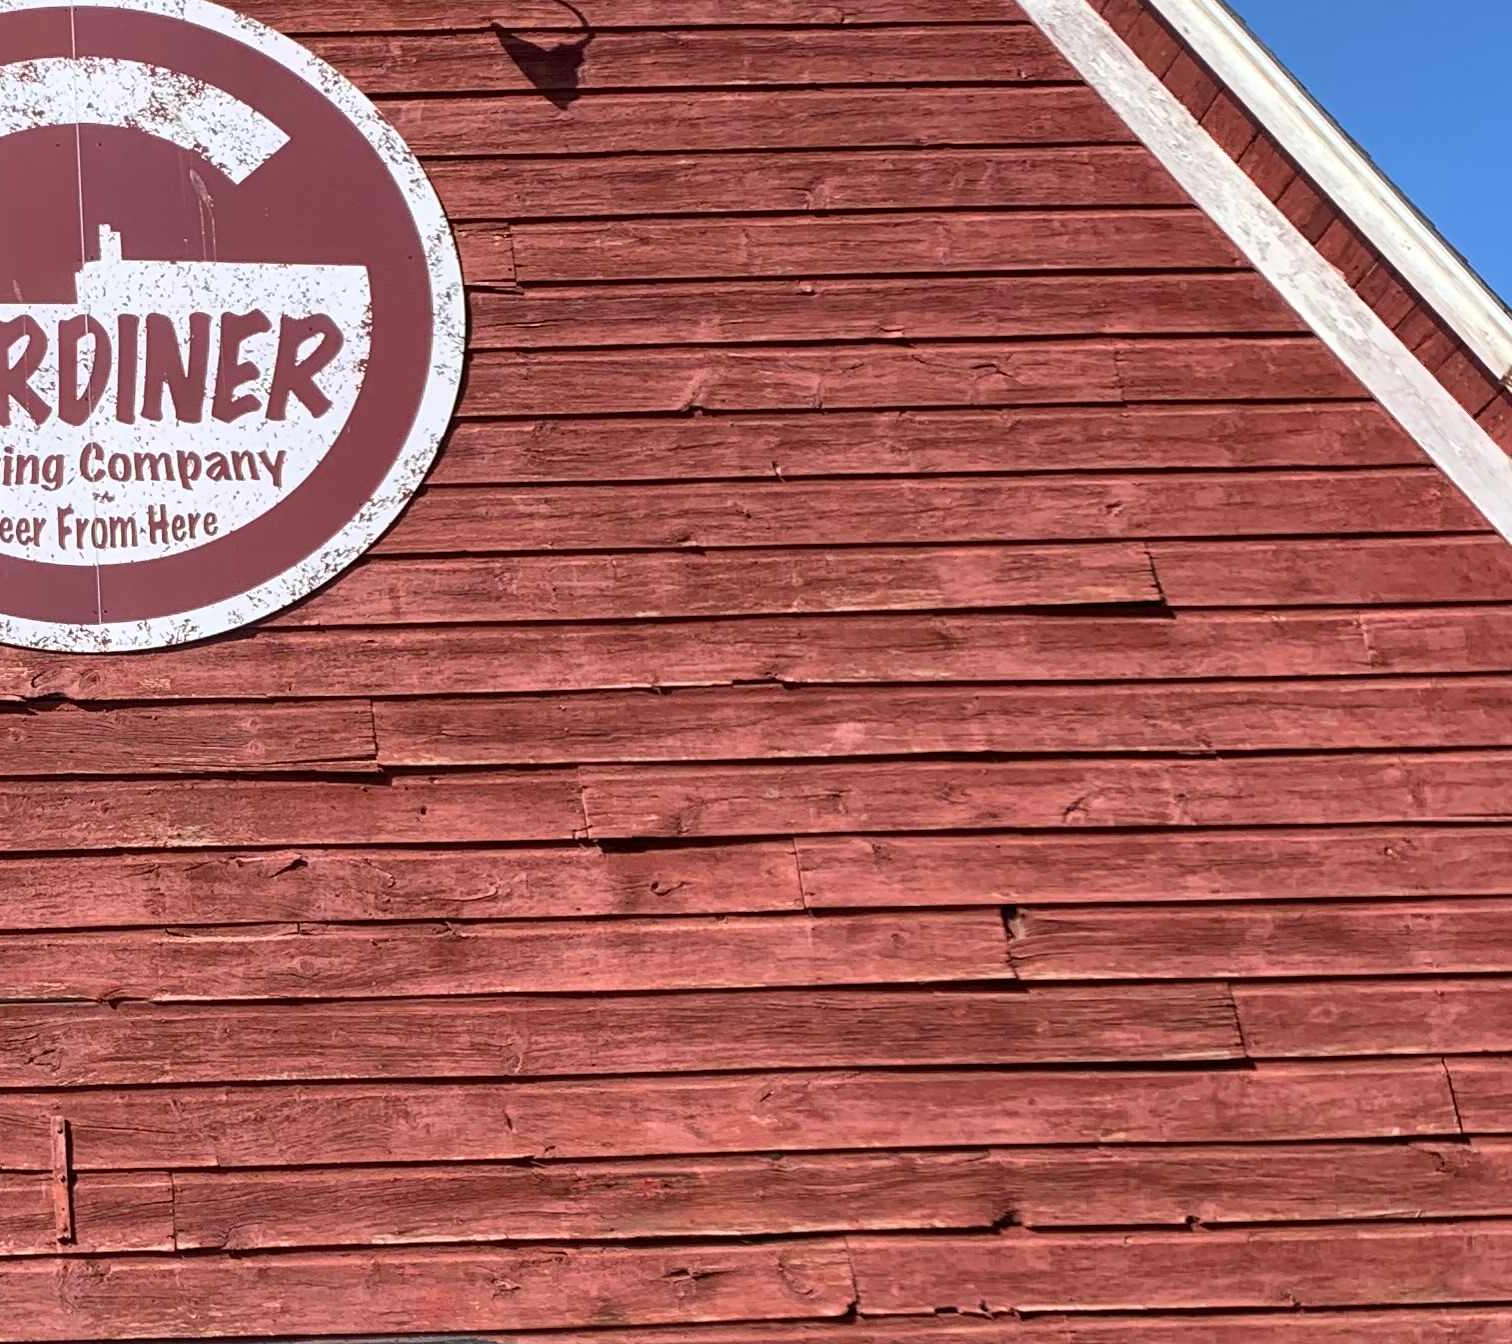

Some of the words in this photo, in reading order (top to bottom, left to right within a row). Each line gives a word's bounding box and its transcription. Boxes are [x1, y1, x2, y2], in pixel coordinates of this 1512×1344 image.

[79, 442, 286, 489] Company
[57, 505, 139, 550] From
[146, 503, 219, 549] Here
